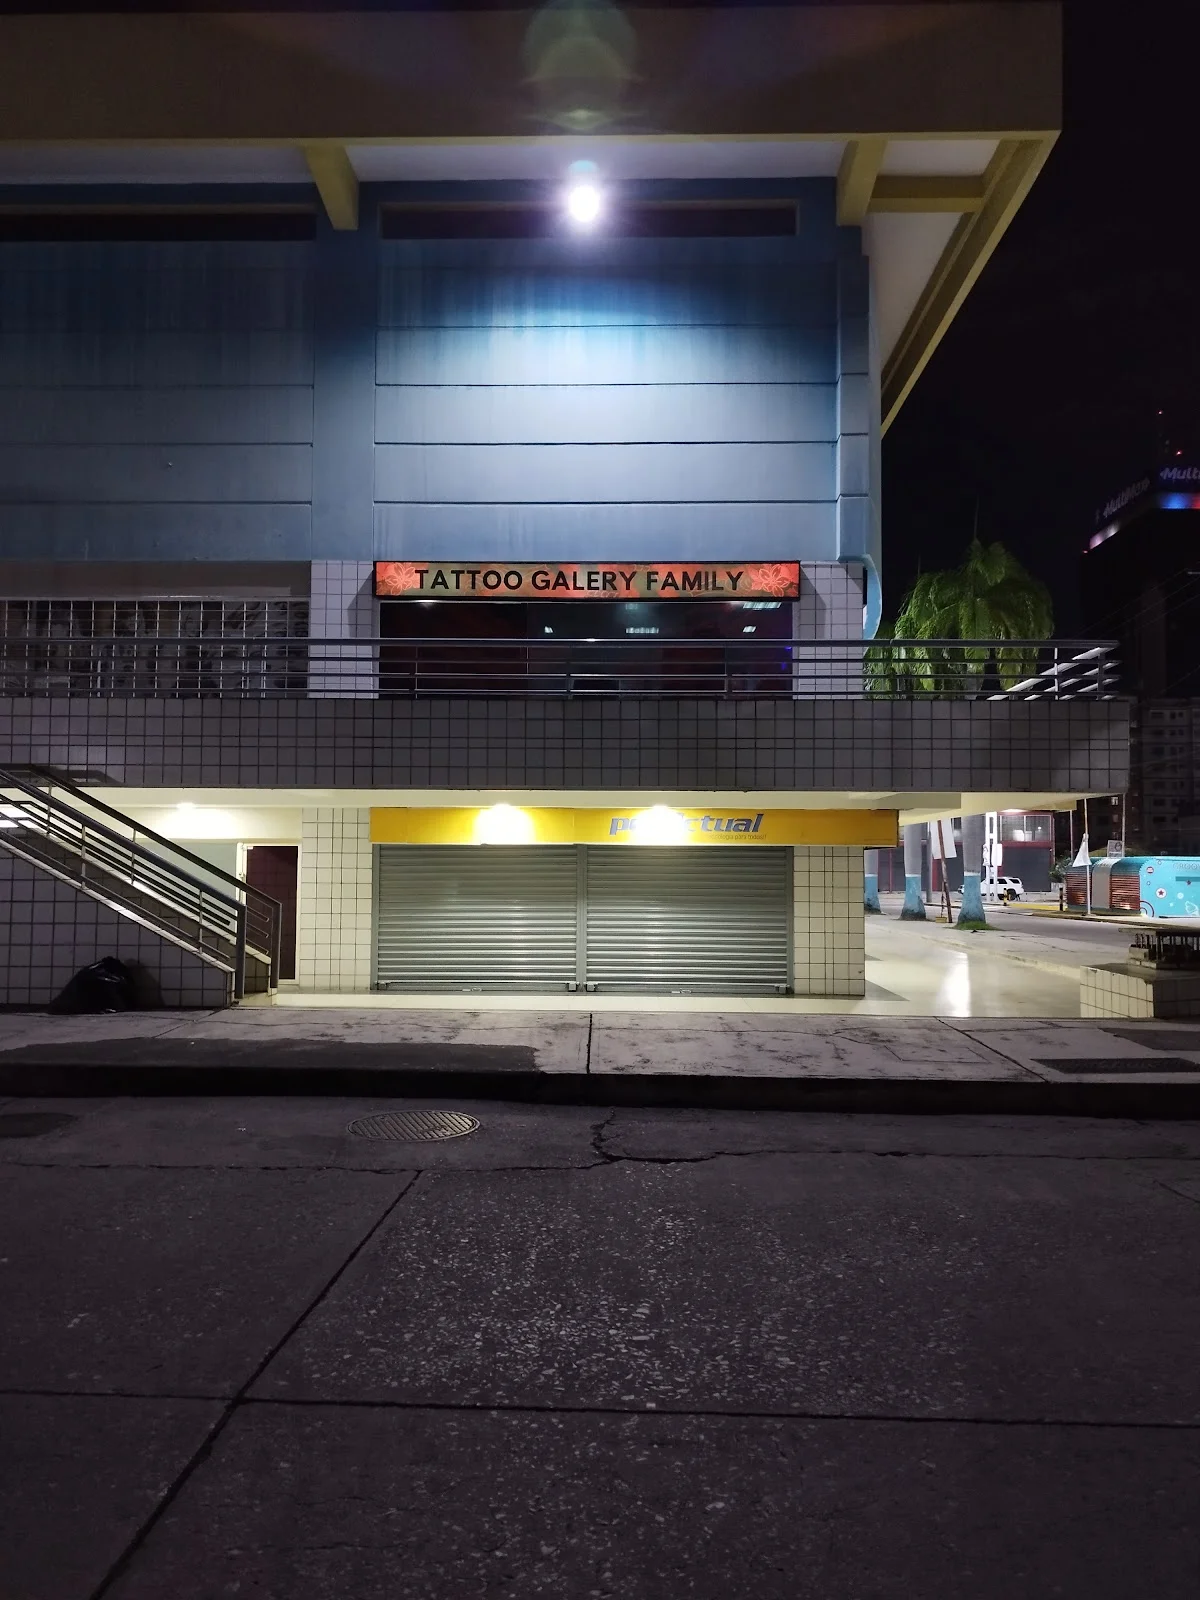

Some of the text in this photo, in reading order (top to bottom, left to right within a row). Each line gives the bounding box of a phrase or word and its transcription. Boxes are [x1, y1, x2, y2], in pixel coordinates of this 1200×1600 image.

[415, 569, 744, 591] TATTOO GALERY FAMILY
